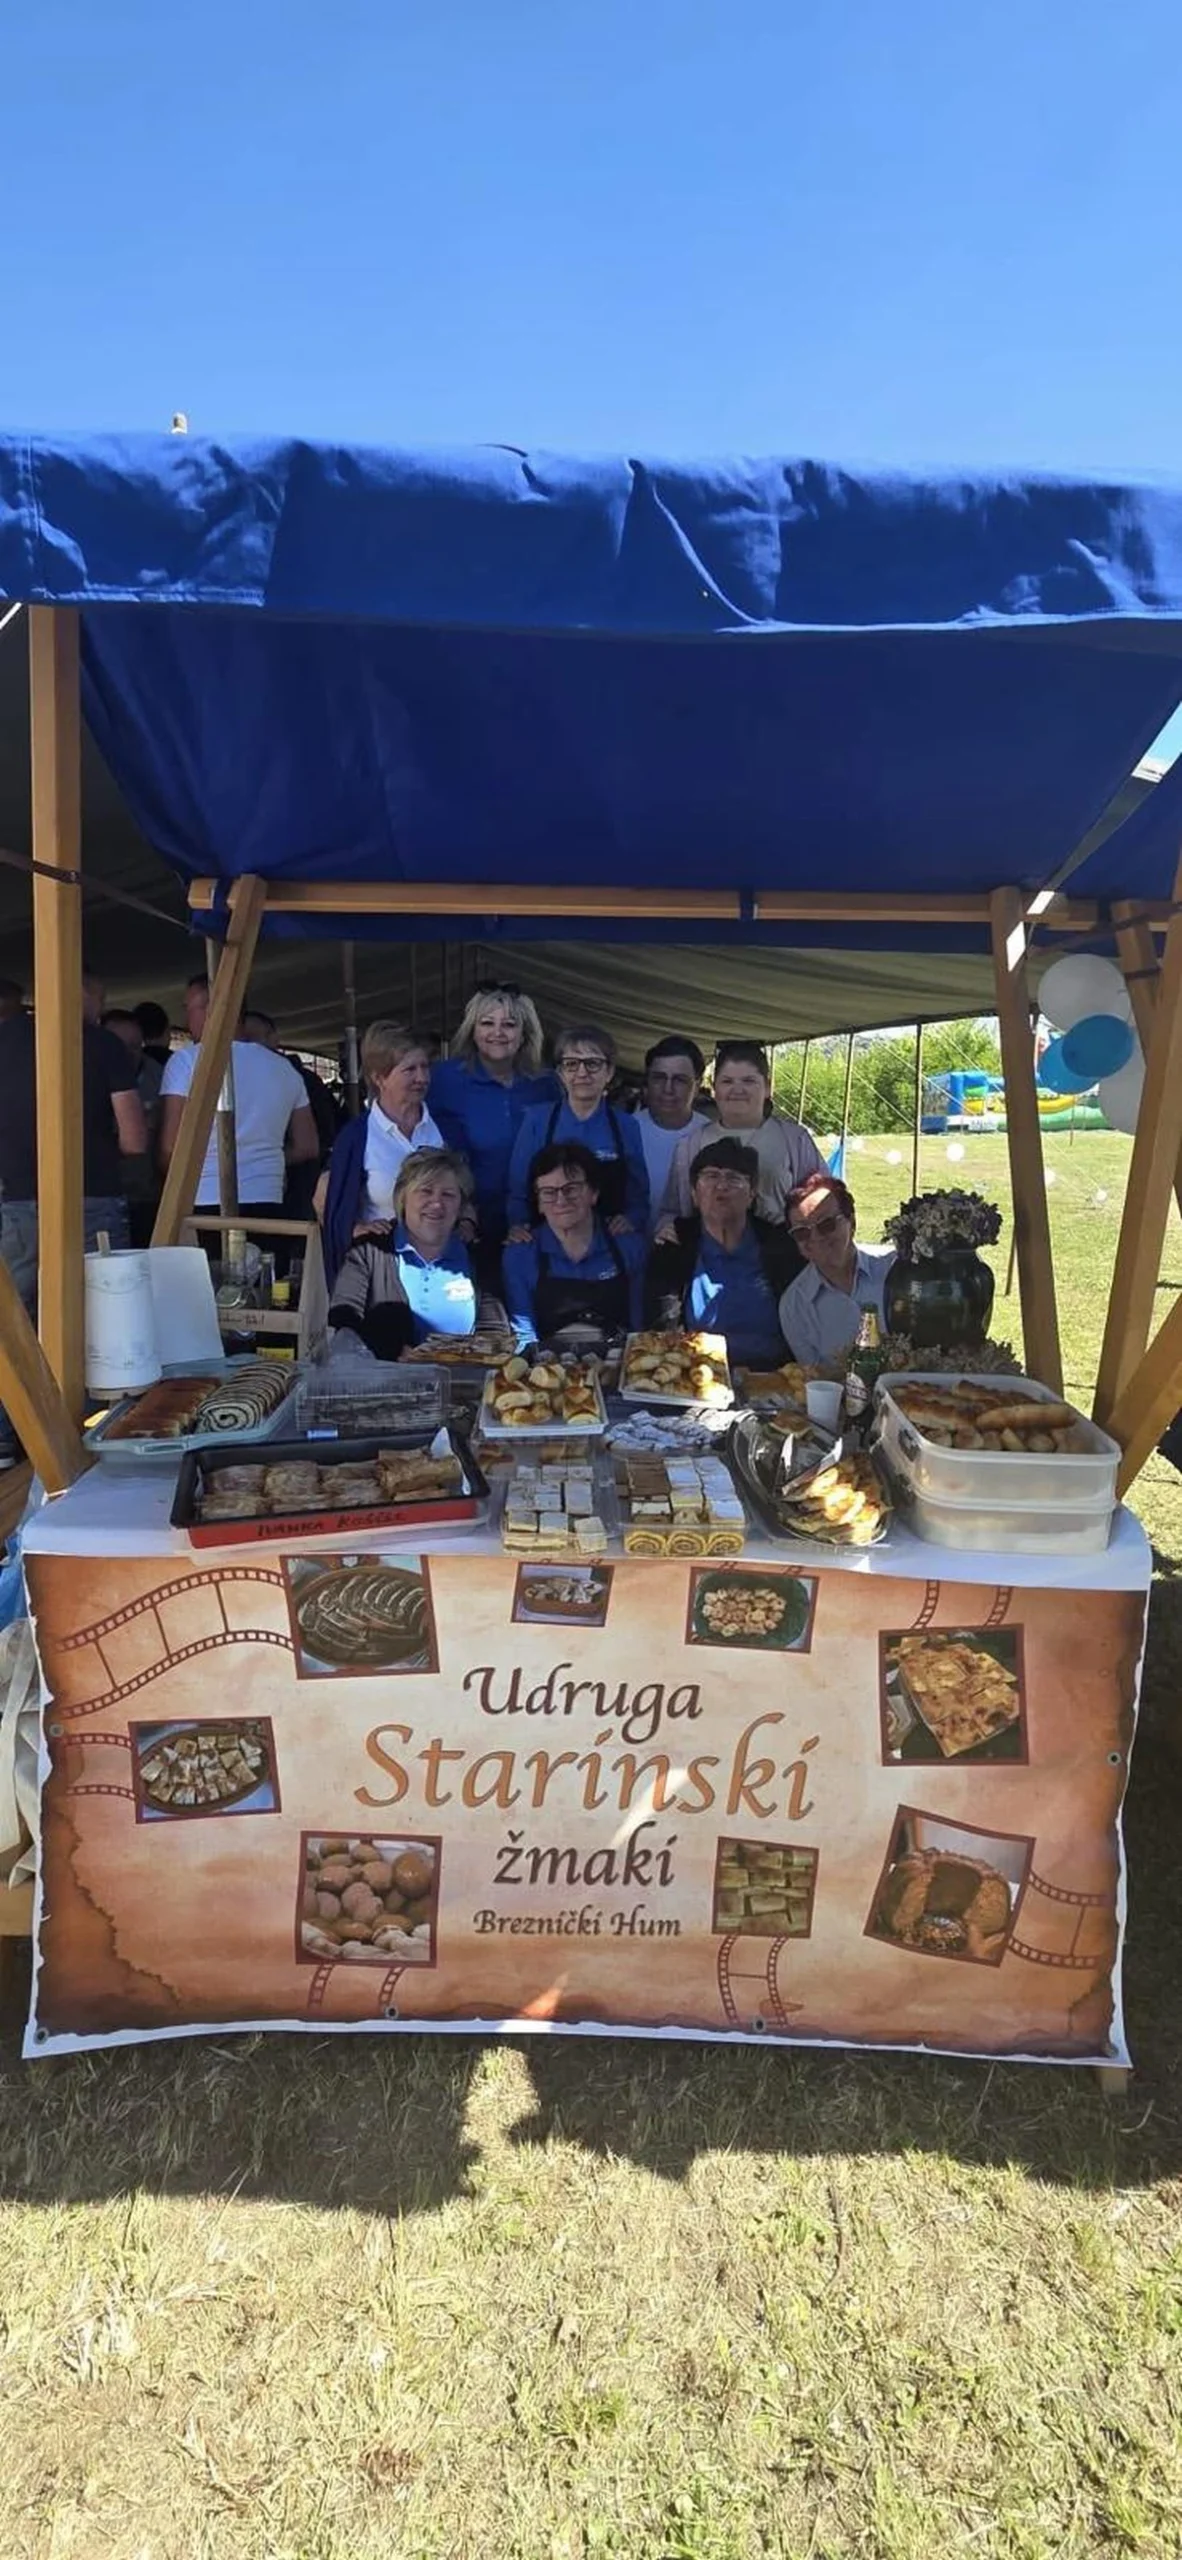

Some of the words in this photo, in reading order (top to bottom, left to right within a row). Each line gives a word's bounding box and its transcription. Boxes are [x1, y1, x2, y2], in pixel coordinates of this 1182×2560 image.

[256, 1521, 325, 1537] IVANKA
[463, 1662, 703, 1745] Udruga
[353, 1712, 820, 1820] Starinski
[494, 1820, 679, 1887] žmaki
[473, 1903, 603, 1936] Breznički
[610, 1903, 683, 1936] Hum
